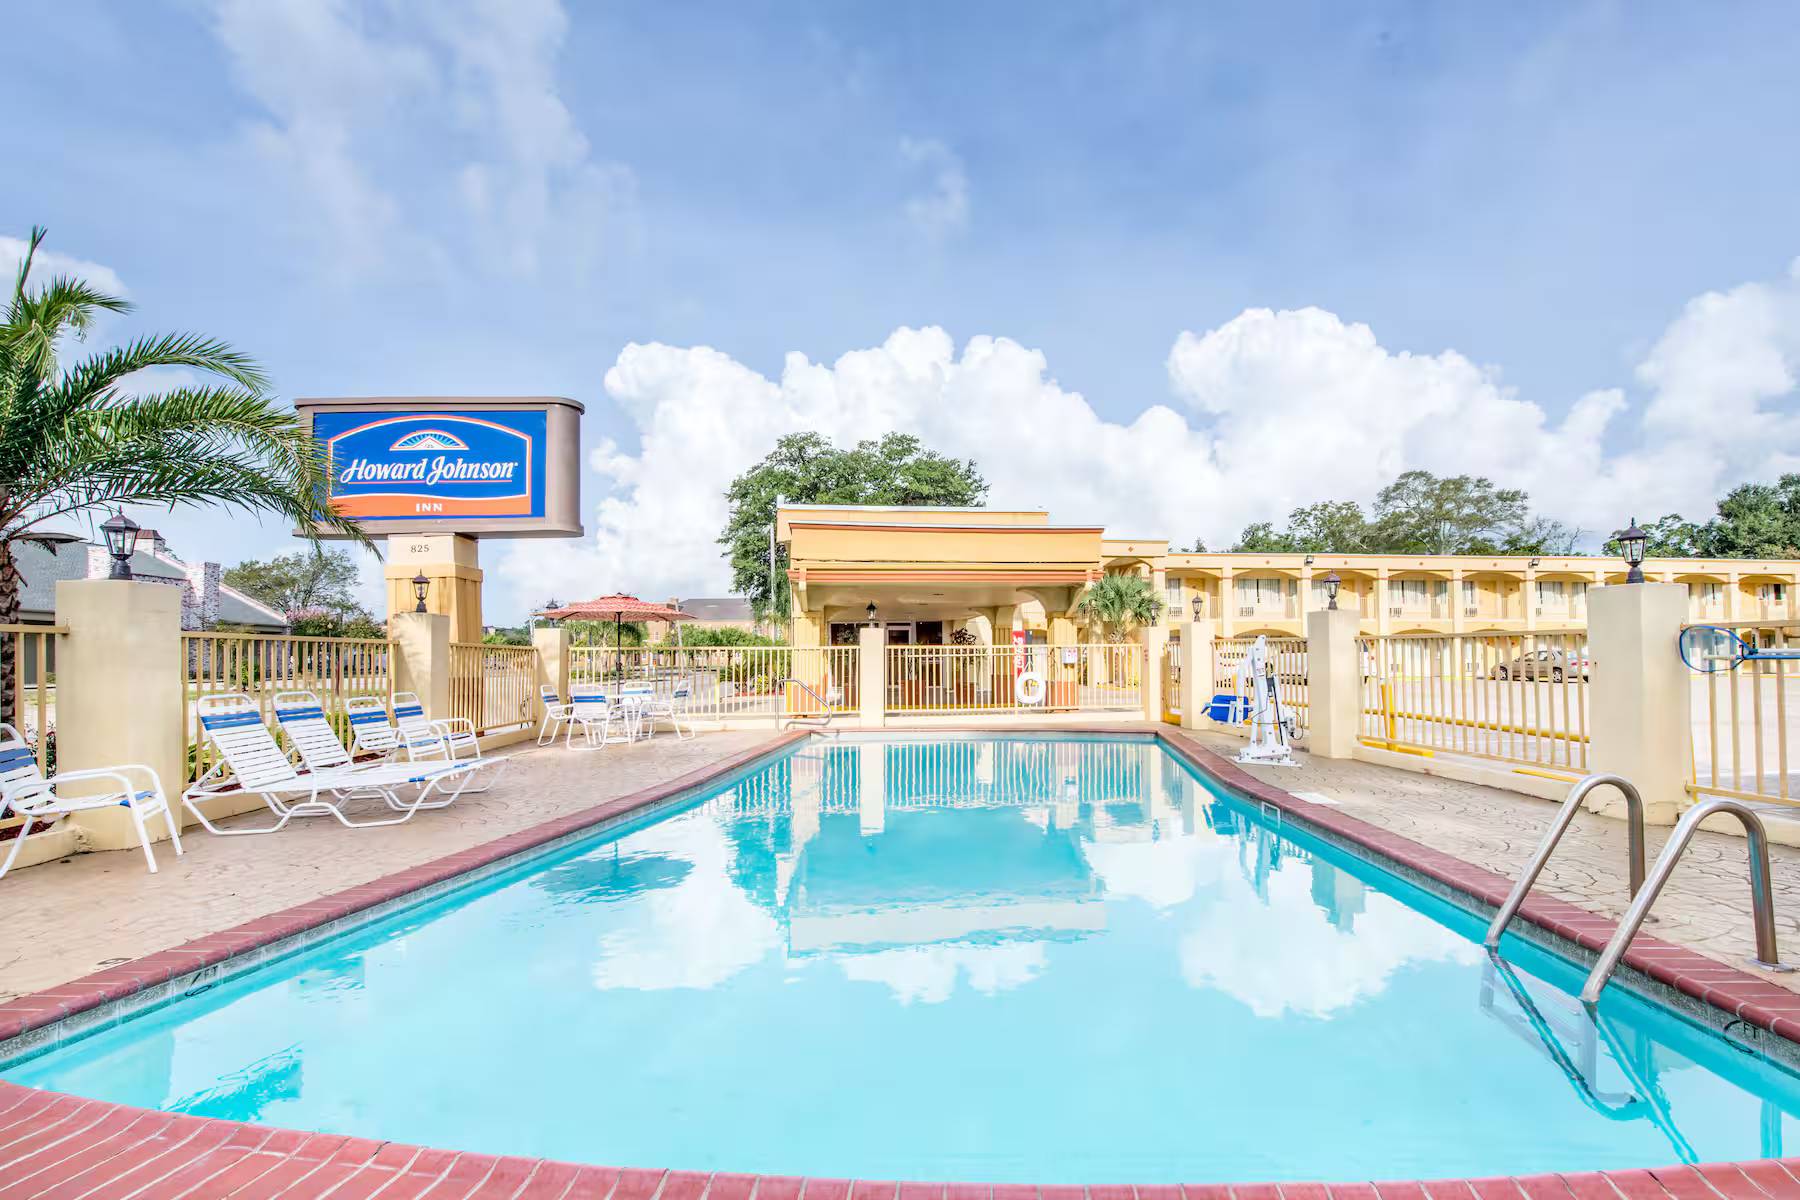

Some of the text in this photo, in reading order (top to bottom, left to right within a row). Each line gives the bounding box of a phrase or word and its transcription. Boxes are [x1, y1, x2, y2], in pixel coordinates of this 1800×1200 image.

[340, 456, 514, 485] Howard Johnson
[415, 503, 442, 513] INN
[410, 544, 430, 553] 825
[1743, 1021, 1759, 1039] FT
